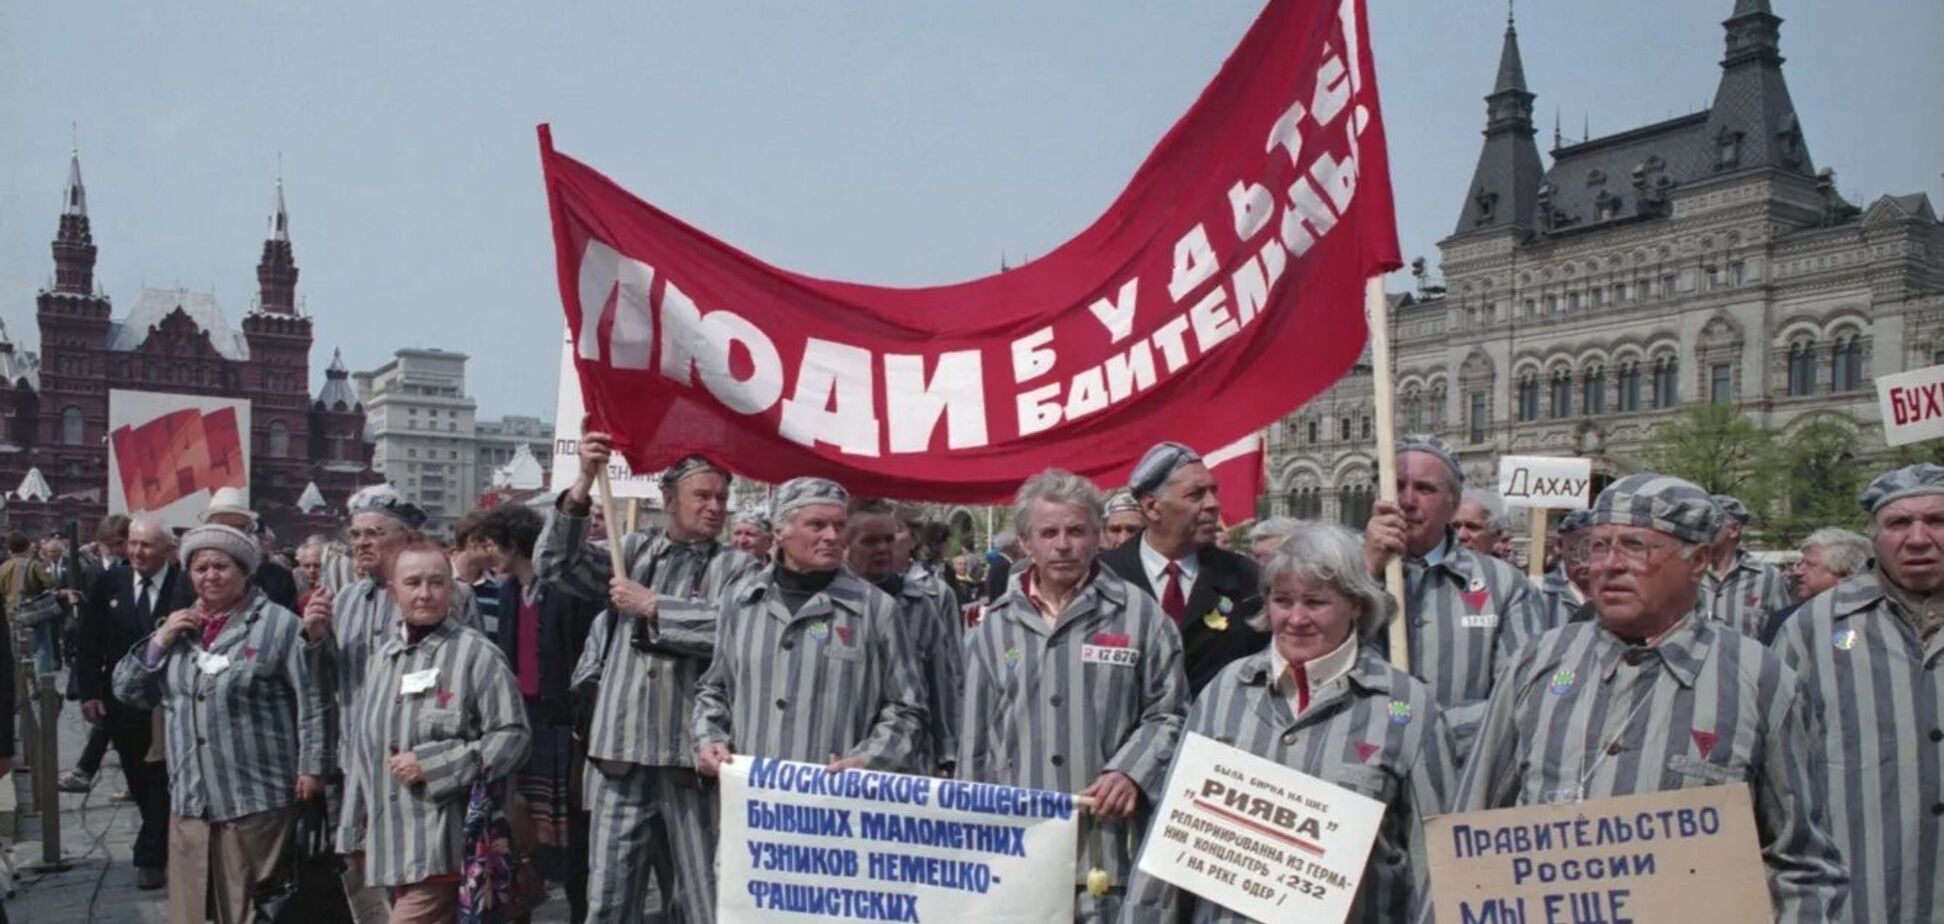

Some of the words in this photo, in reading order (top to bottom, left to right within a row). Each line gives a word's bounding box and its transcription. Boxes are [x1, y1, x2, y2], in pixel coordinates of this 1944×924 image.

[1011, 40, 1350, 384] БУДЬТЕ
[578, 239, 988, 457] ЛЮДИ
[1889, 382, 1944, 426] БУХ
[1287, 792, 1303, 804] НА
[747, 840, 858, 877] УЗНИКОВ
[868, 852, 1001, 894] НЕМЕЦКО-
[1187, 855, 1204, 873] НА
[1207, 864, 1238, 886] РЕКЕ
[1242, 878, 1275, 901] ОДЕР
[1193, 837, 1270, 877] КОНЦЛАГЕРЬ
[1286, 853, 1304, 871] ИЗ
[747, 879, 920, 924] ФАШИСТСКИХ
